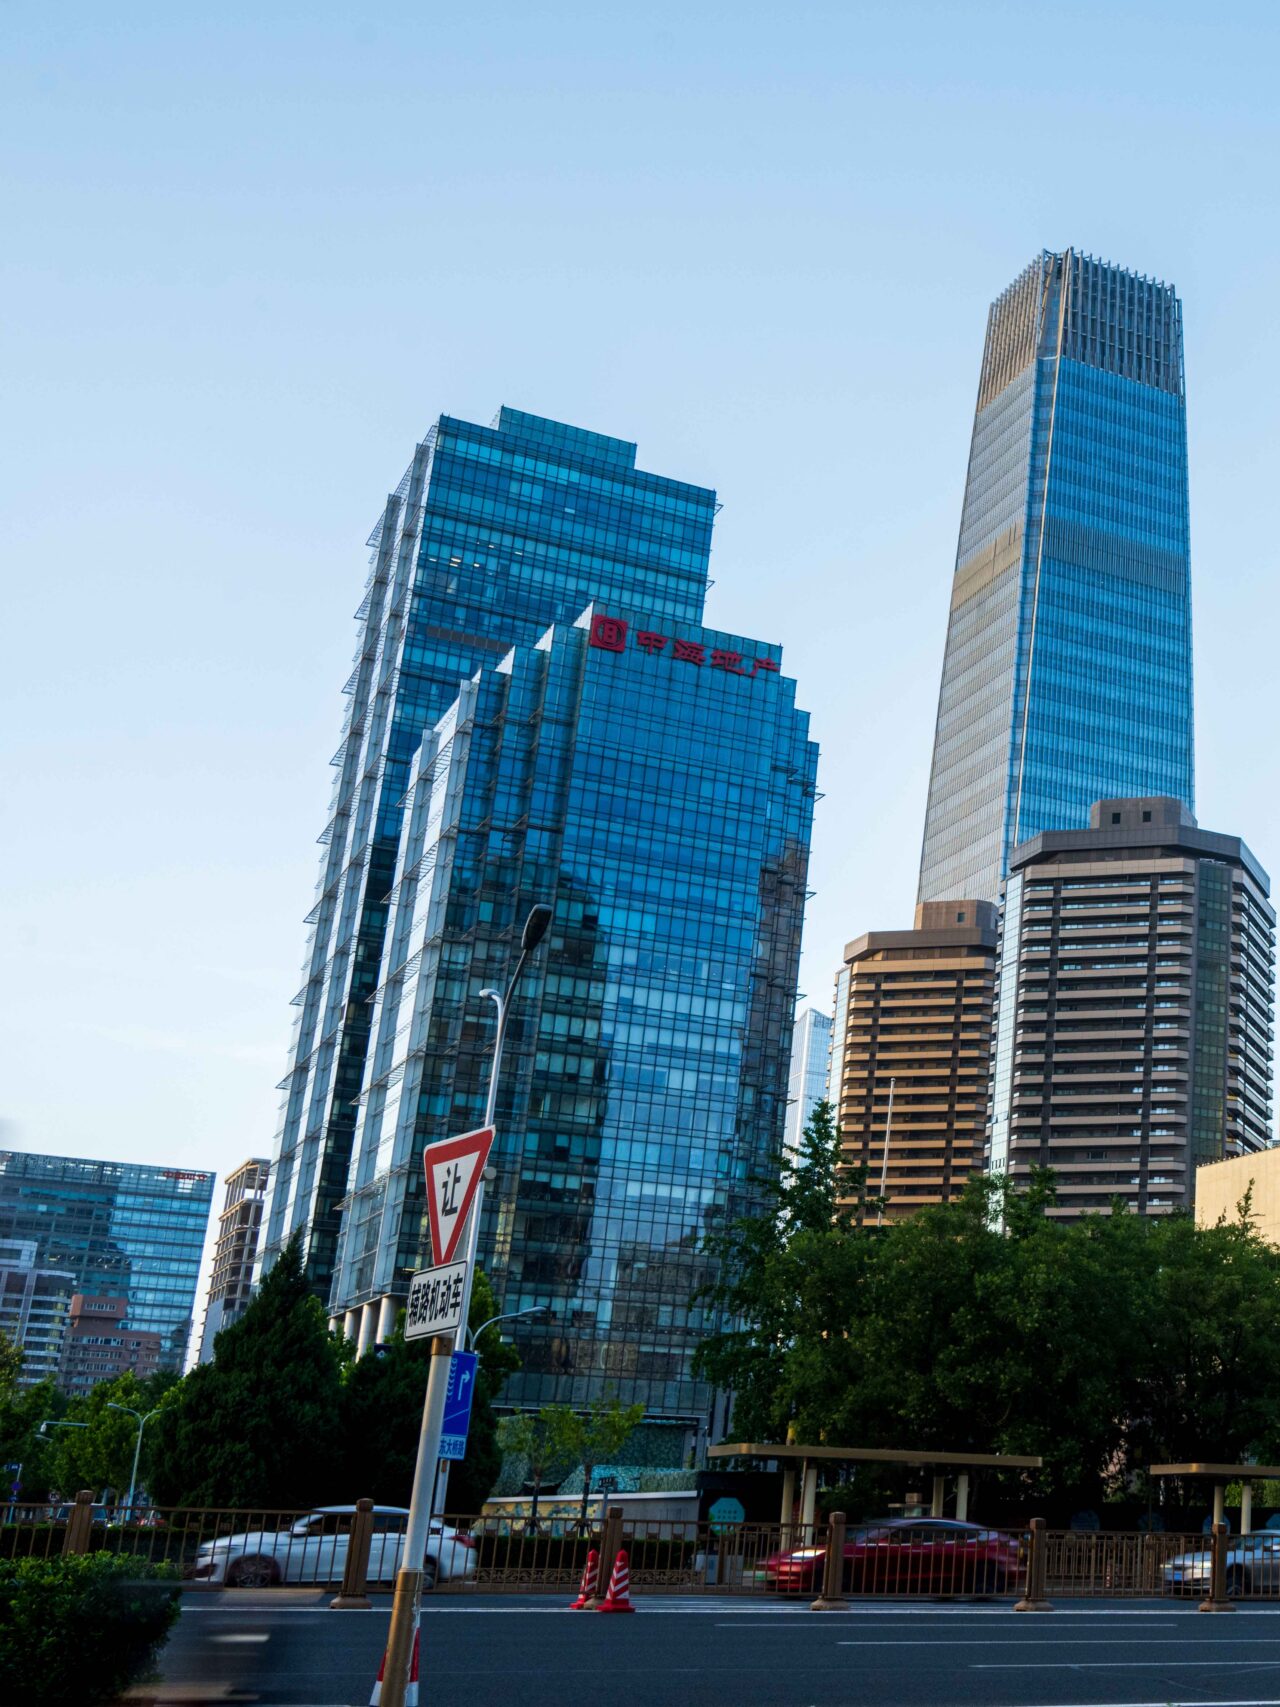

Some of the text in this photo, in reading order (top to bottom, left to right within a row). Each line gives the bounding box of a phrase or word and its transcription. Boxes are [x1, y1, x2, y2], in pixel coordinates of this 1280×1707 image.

[636, 630, 781, 677] 中海地产
[441, 1162, 462, 1217] 让
[409, 1272, 463, 1328] 辅路机动车
